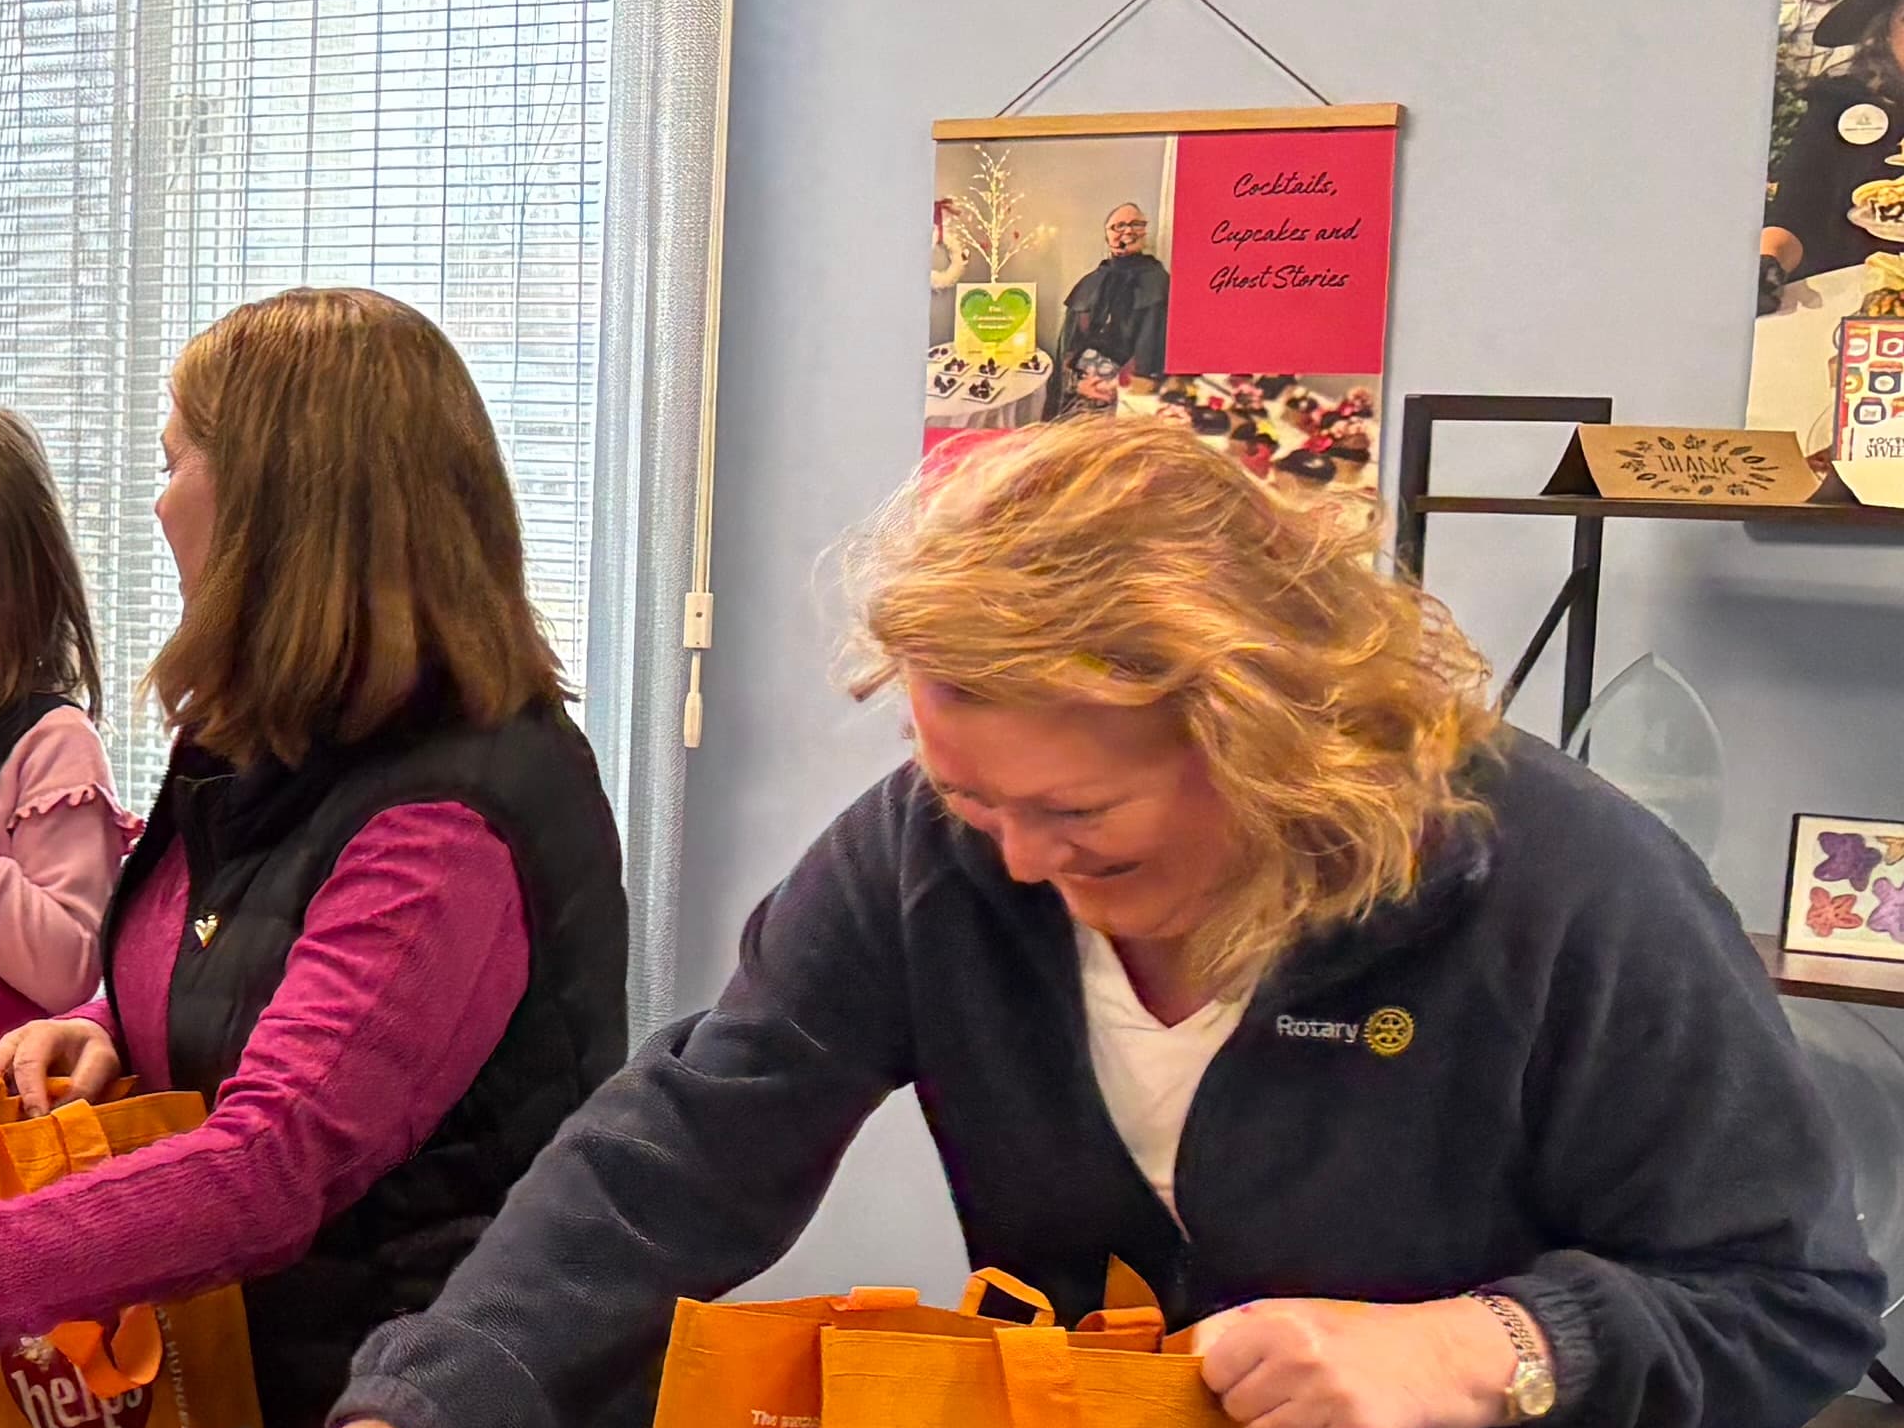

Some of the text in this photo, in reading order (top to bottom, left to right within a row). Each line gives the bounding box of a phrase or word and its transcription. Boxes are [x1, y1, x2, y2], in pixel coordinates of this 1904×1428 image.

[1233, 171, 1337, 198] Cocktails,
[1211, 217, 1362, 252] Cupcakes and
[1209, 264, 1350, 294] Ghost Stories
[1655, 455, 1736, 475] THANK
[1276, 1013, 1359, 1043] Rotary
